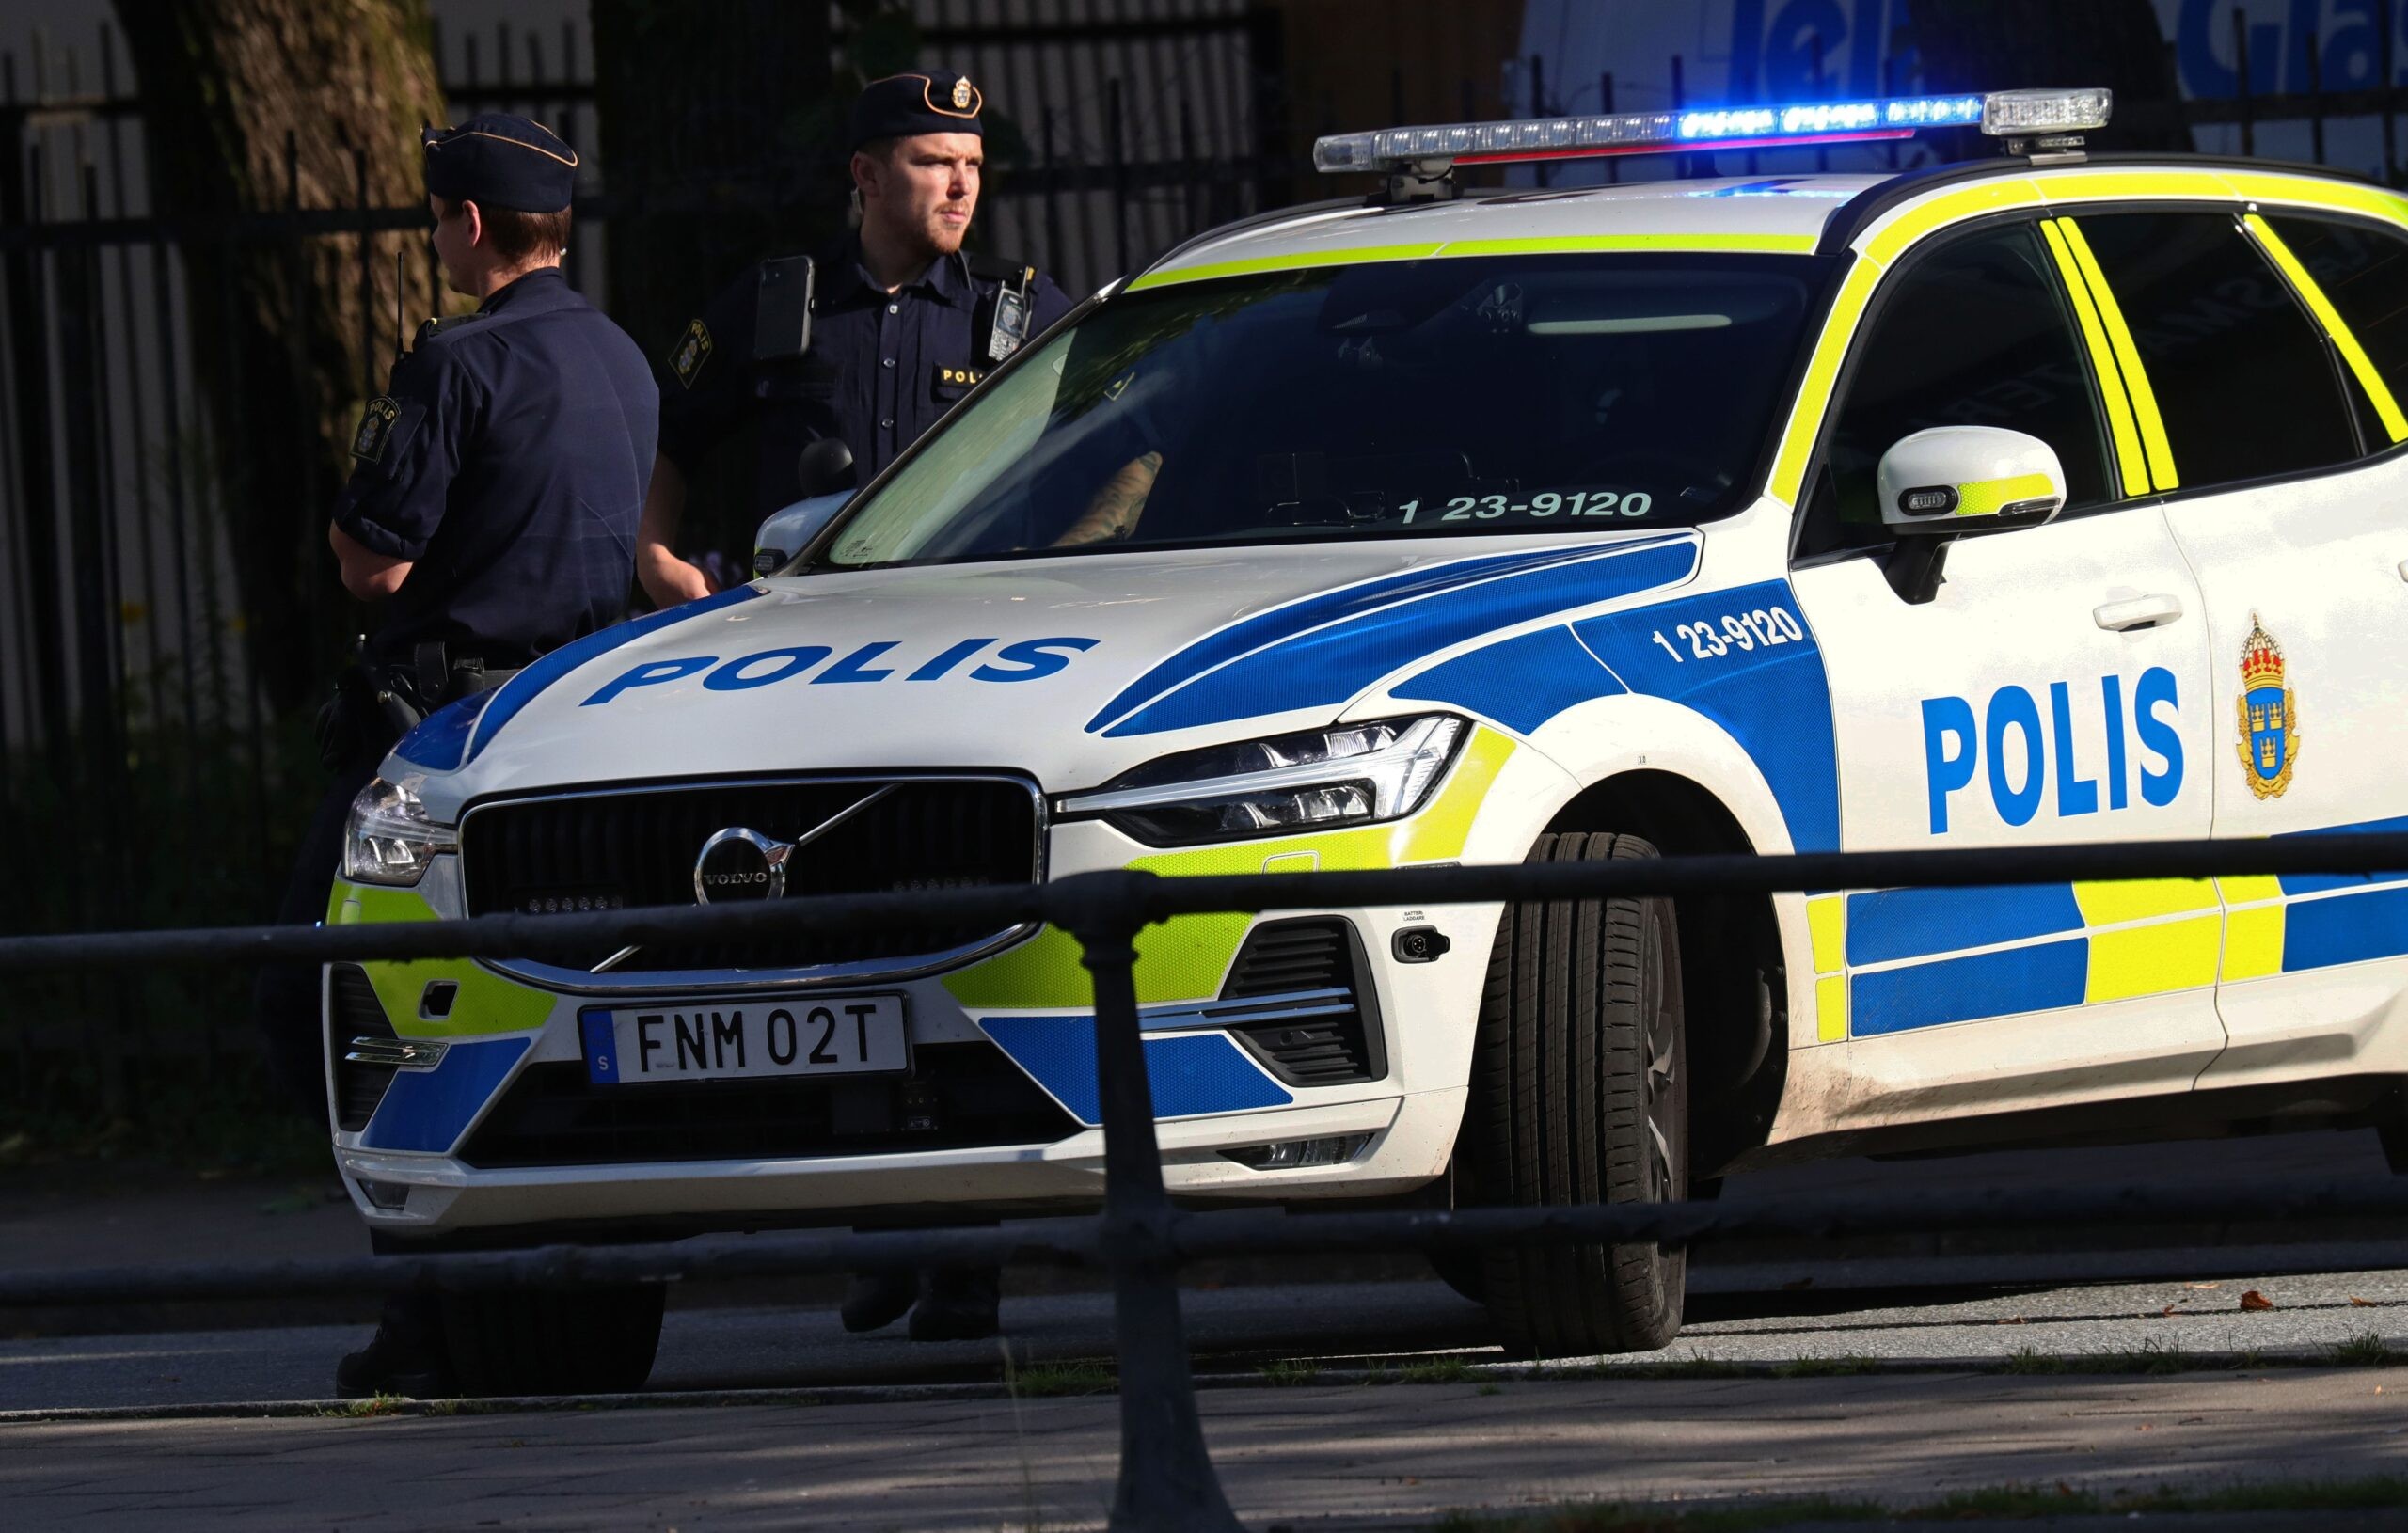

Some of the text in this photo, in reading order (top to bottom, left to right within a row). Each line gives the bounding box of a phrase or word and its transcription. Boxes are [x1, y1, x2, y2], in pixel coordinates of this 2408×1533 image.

[691, 323, 709, 351] POLIS
[943, 369, 983, 384] POL
[369, 401, 395, 420] POLIS
[1398, 492, 1652, 524] 1 23-9120
[1652, 607, 1803, 662] 1 23-9120
[578, 637, 1101, 707] POLIS
[1921, 666, 2184, 835] POLIS
[704, 872, 768, 885] VOLVO
[637, 1004, 876, 1072] FNM 02T
[598, 1055, 609, 1071] S
